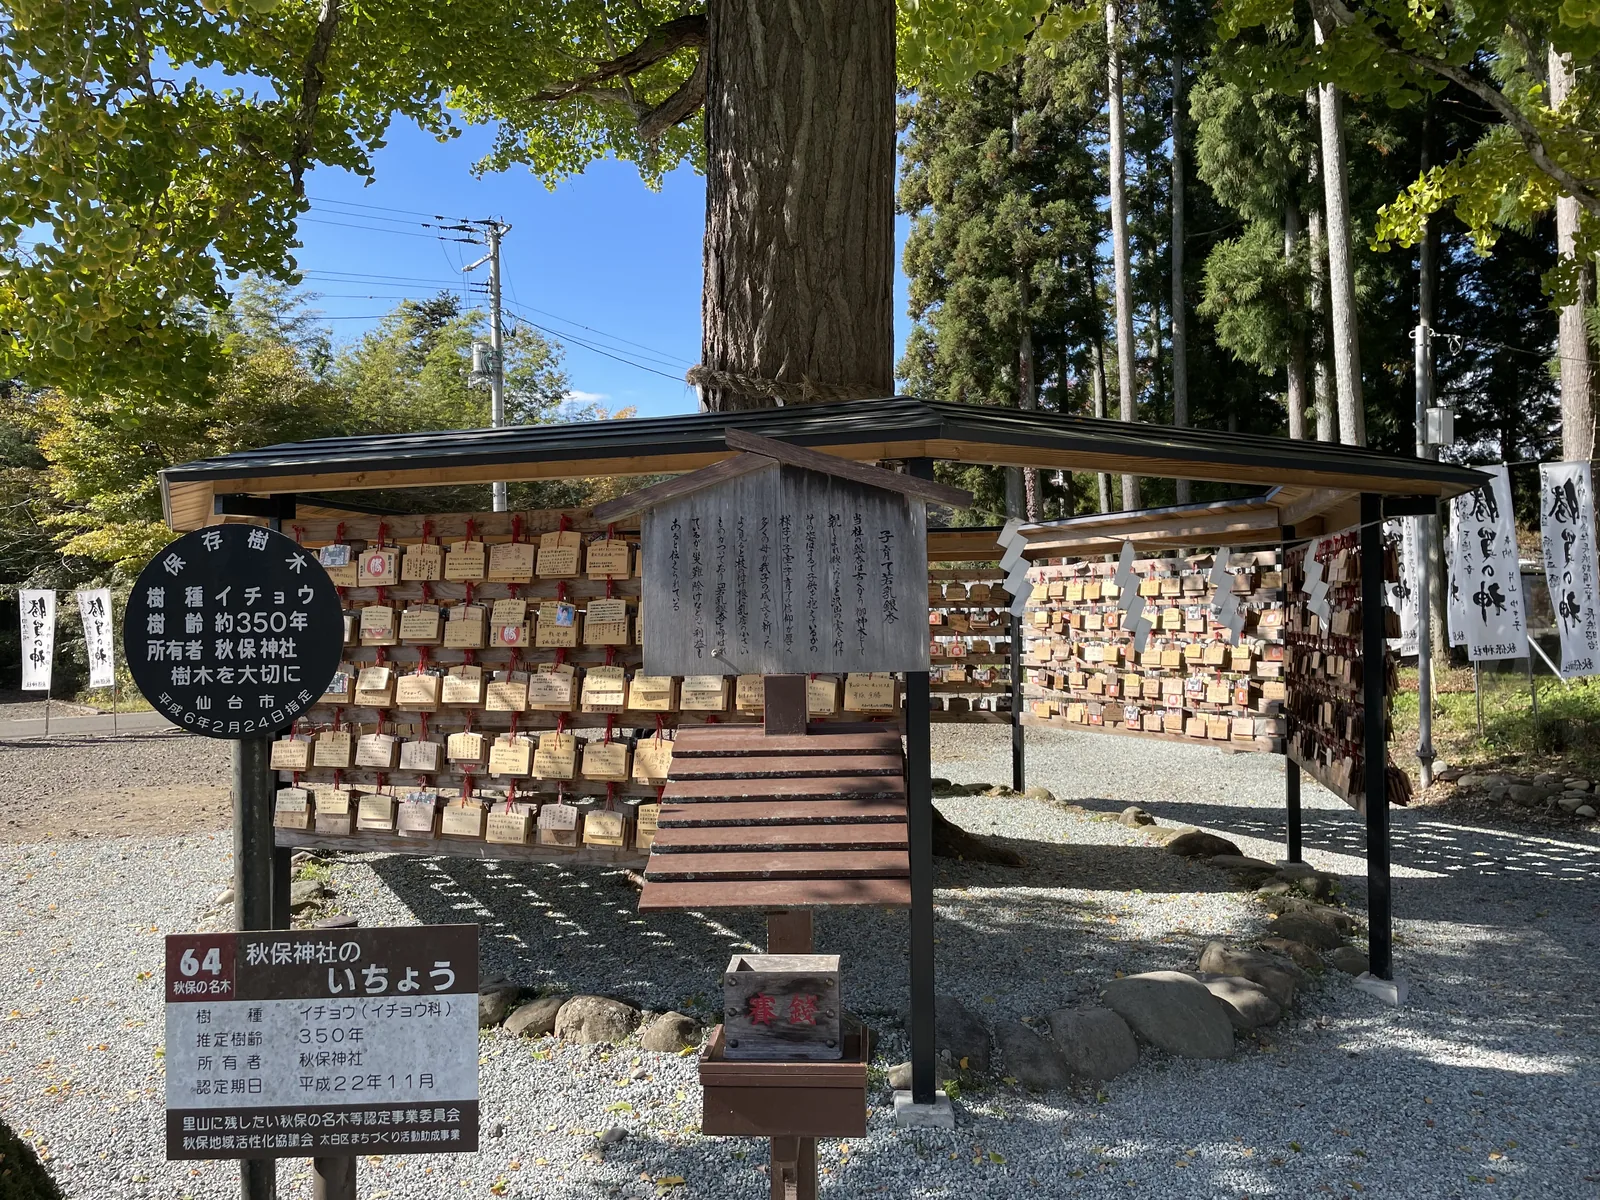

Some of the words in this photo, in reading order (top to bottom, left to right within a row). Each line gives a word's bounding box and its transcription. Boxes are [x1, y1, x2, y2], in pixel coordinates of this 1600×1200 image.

[162, 528, 308, 576] 保存樹木
[146, 585, 204, 608] 樹種
[214, 584, 315, 607] イチョウ
[146, 612, 204, 635] 樹齢
[214, 610, 309, 634] 約350年
[146, 638, 204, 662] 所有者
[214, 637, 298, 660] 秋保神社
[170, 664, 302, 686] 樹木を大切に
[158, 688, 313, 734] 平成6年2月24日指定
[195, 694, 275, 711] 仙台市
[179, 947, 222, 977] 64
[246, 940, 361, 966] 秋保神社の
[173, 978, 232, 994] 秋保の名木
[328, 960, 456, 995] いちょう
[196, 1031, 263, 1048] 推定樹齢
[299, 1027, 364, 1045] 350年
[196, 1054, 262, 1072] 所有者
[299, 1051, 363, 1068] 秋保神社
[196, 1077, 263, 1095] 認定期日
[299, 1073, 435, 1093] 平成22年11月
[182, 1107, 461, 1132] 里山に残したい秋保の名木等認定事業委員会
[182, 1132, 314, 1151] 秋保地域活性化協議会
[319, 1128, 461, 1146] 太白区まちづくり活動助成事業
